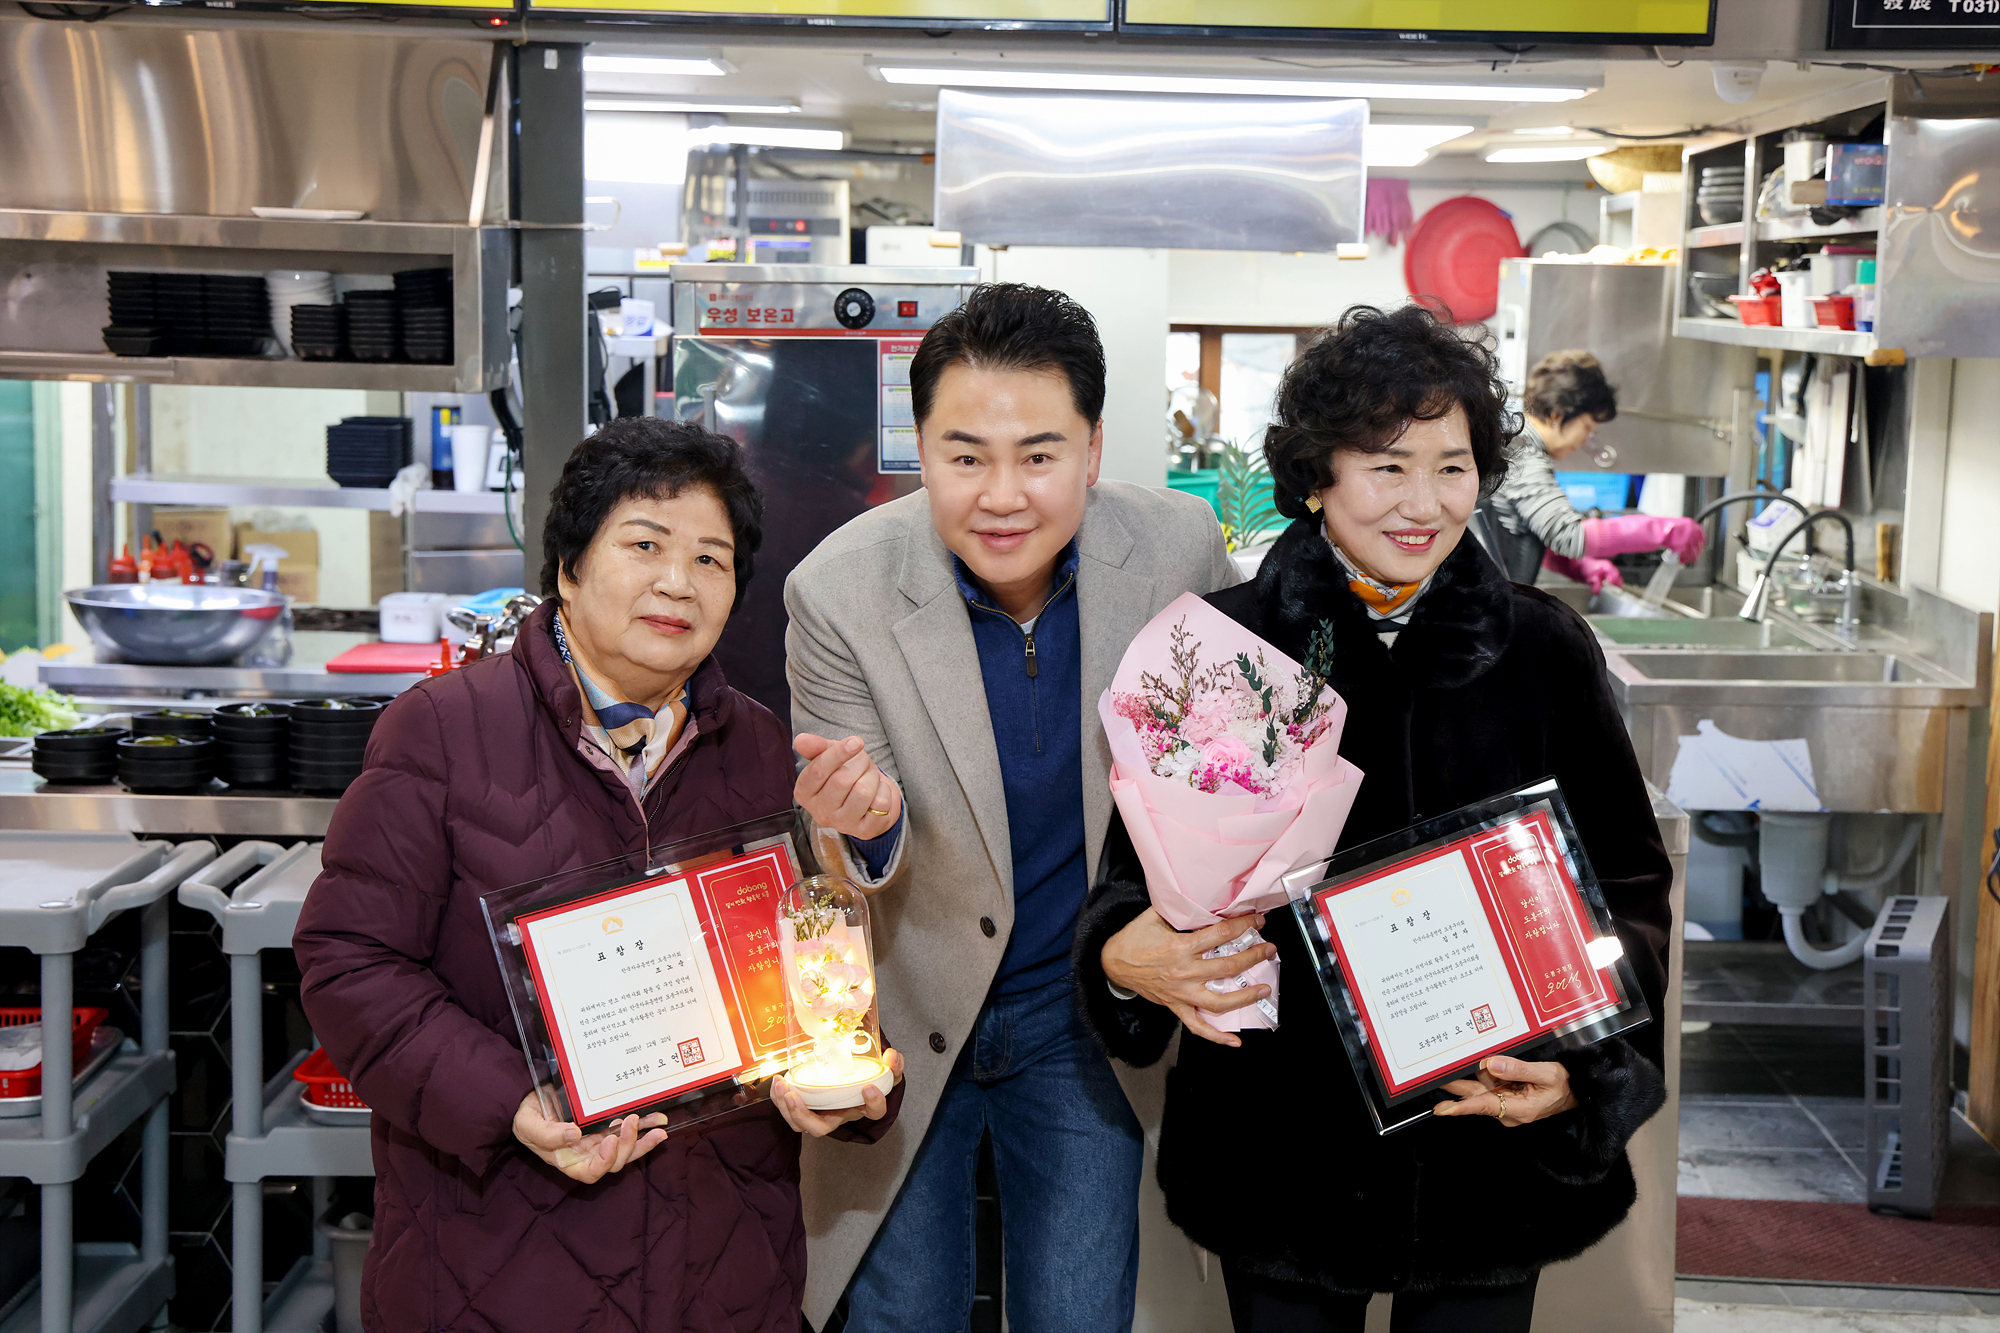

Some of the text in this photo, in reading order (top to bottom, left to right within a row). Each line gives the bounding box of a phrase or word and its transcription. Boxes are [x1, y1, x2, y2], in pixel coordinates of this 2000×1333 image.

[708, 308, 794, 323] 우성 보온고
[1508, 850, 1534, 864] dobog
[736, 882, 768, 896] dobong
[1526, 920, 1560, 940] 자랑입니다
[748, 956, 780, 972] 자랑입니
